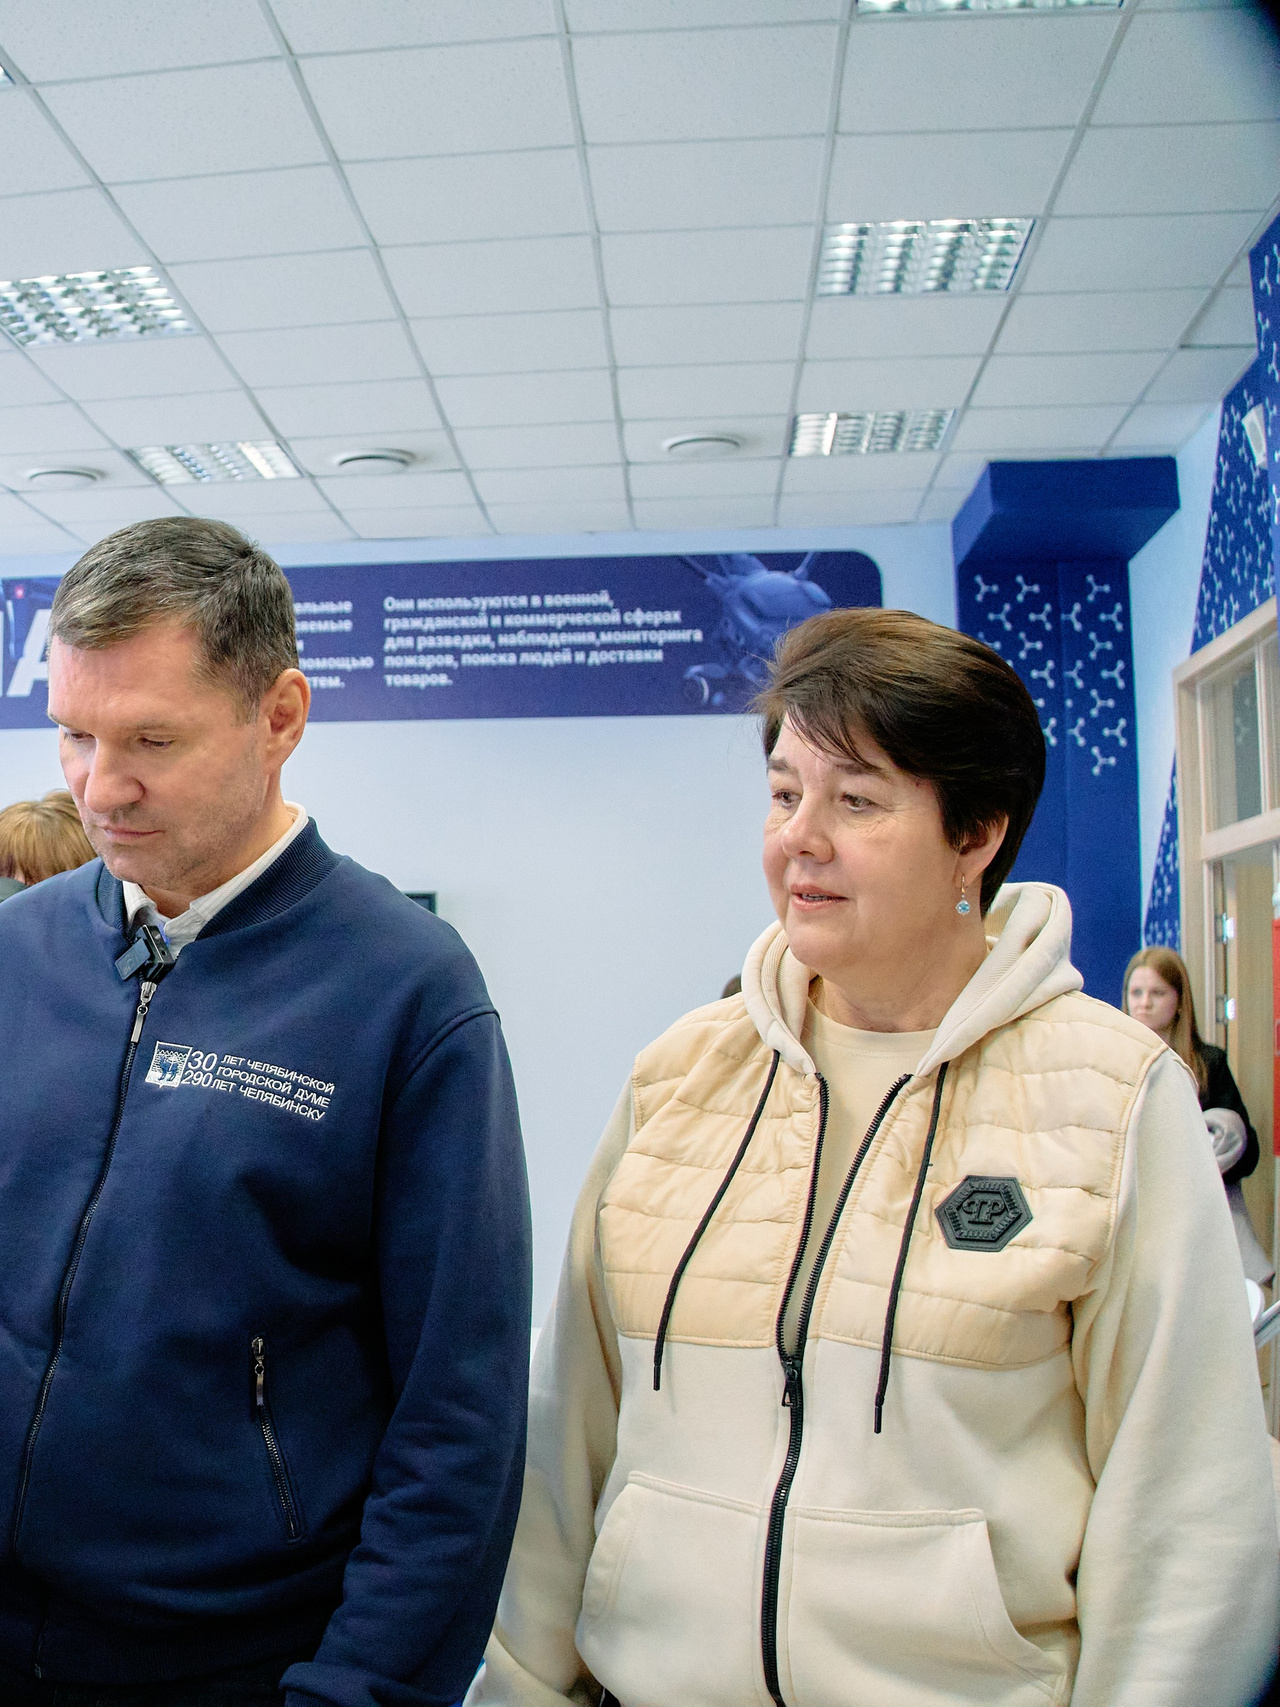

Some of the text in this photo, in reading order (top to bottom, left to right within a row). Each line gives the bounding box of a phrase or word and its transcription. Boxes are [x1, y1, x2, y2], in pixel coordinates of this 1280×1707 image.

[293, 601, 353, 614] ельные
[384, 589, 614, 616] Они используются в военной,
[384, 607, 682, 633] гражданской и коммерческой сферах
[383, 635, 414, 652] для
[417, 633, 496, 651] разведки,
[383, 647, 663, 670] пожаров, поиска людей и доставки
[384, 672, 453, 690] товаров.
[187, 1050, 335, 1095] 30 ЛЕТ ЧЕЛЯБИНСКОЙ
[181, 1070, 326, 1121] 290 ЛЕТ ЧЕЛЯБИНСКУ
[217, 1066, 331, 1108] ГОРОДСКОЙ ДУМЕ
